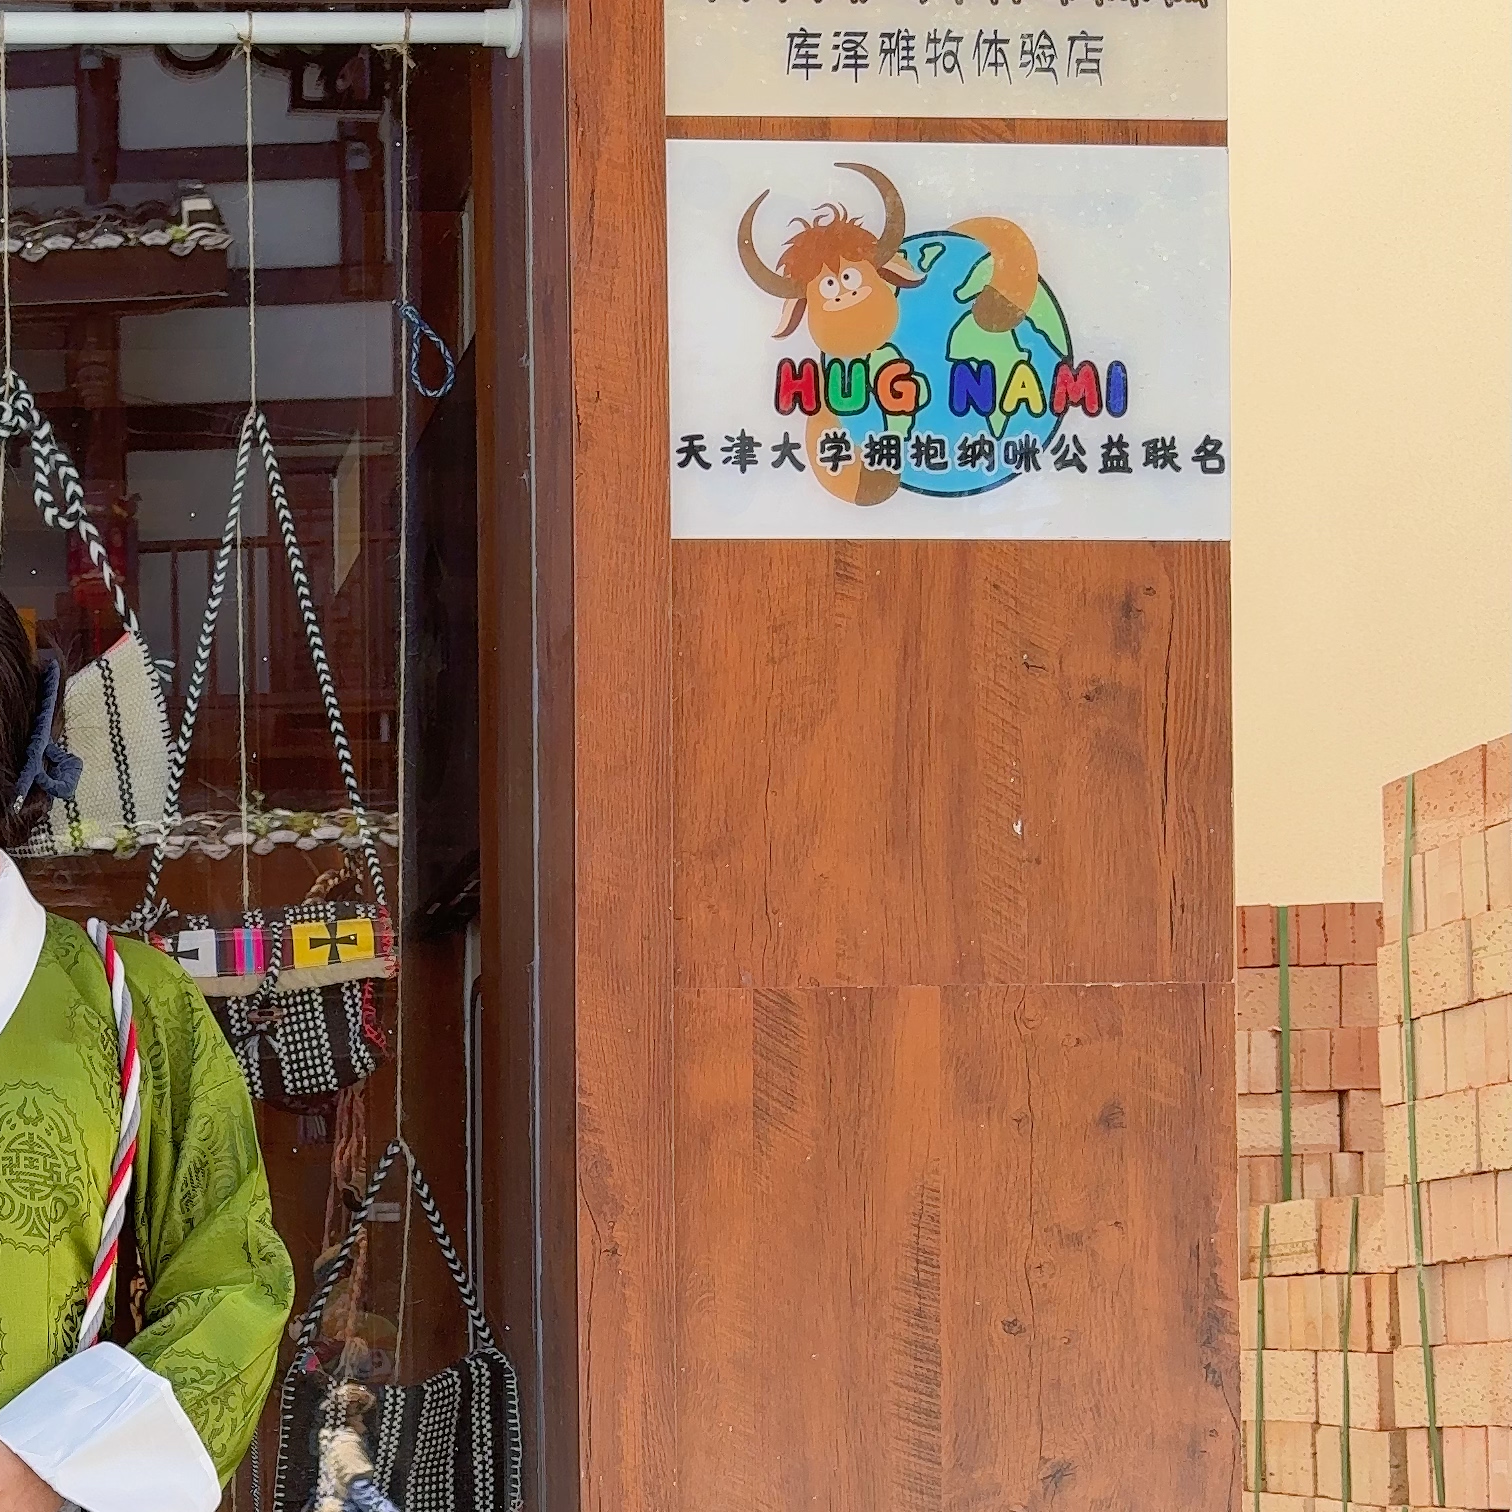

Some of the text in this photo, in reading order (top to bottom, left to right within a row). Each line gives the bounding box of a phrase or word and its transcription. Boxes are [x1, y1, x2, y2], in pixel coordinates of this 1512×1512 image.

[786, 28, 1104, 86] 库泽雅牧体验店
[775, 359, 1127, 417] HUG NAMI
[676, 429, 1226, 474] 天津大学拥抱纳咪公益联名
